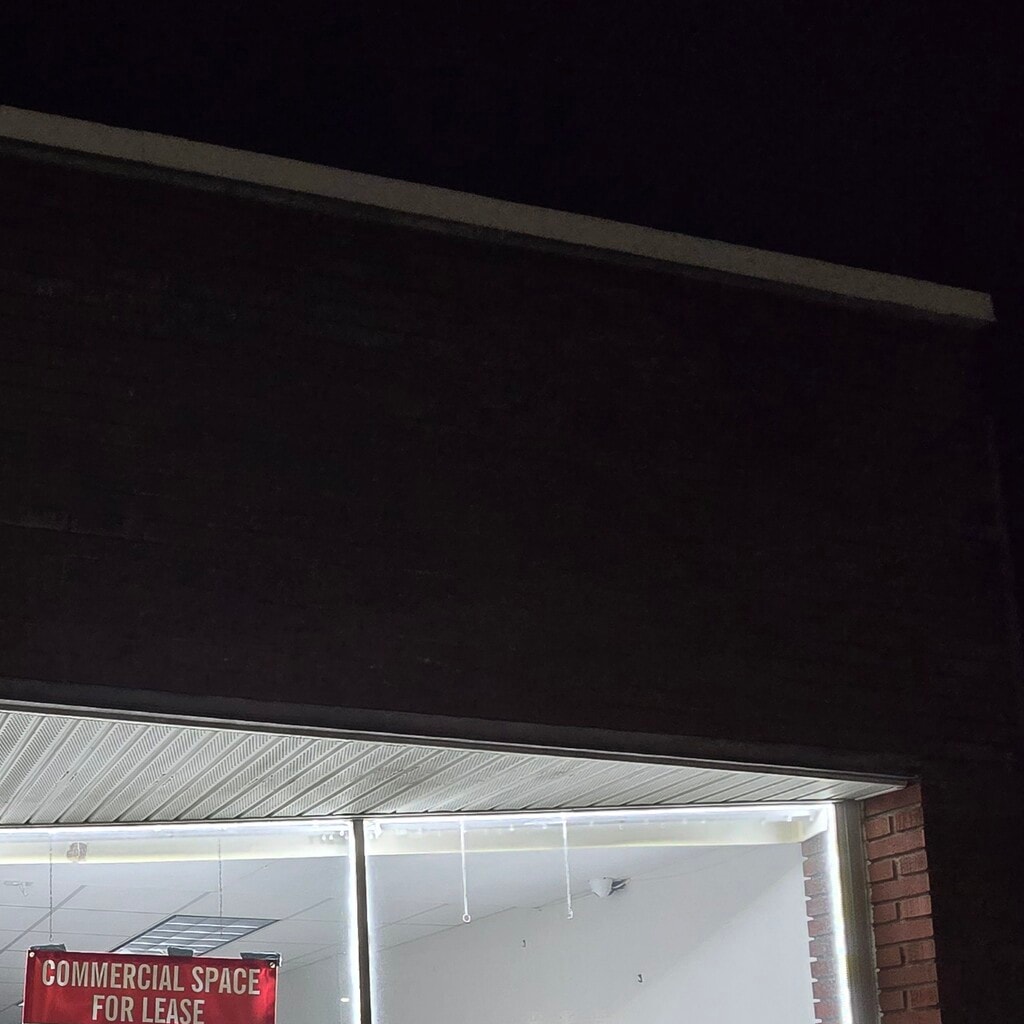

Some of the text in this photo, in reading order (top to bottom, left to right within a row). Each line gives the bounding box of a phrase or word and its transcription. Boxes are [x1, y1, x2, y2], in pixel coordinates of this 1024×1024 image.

[42, 959, 261, 995] COMMERCIAL SPACE
[91, 994, 134, 1023] FOR
